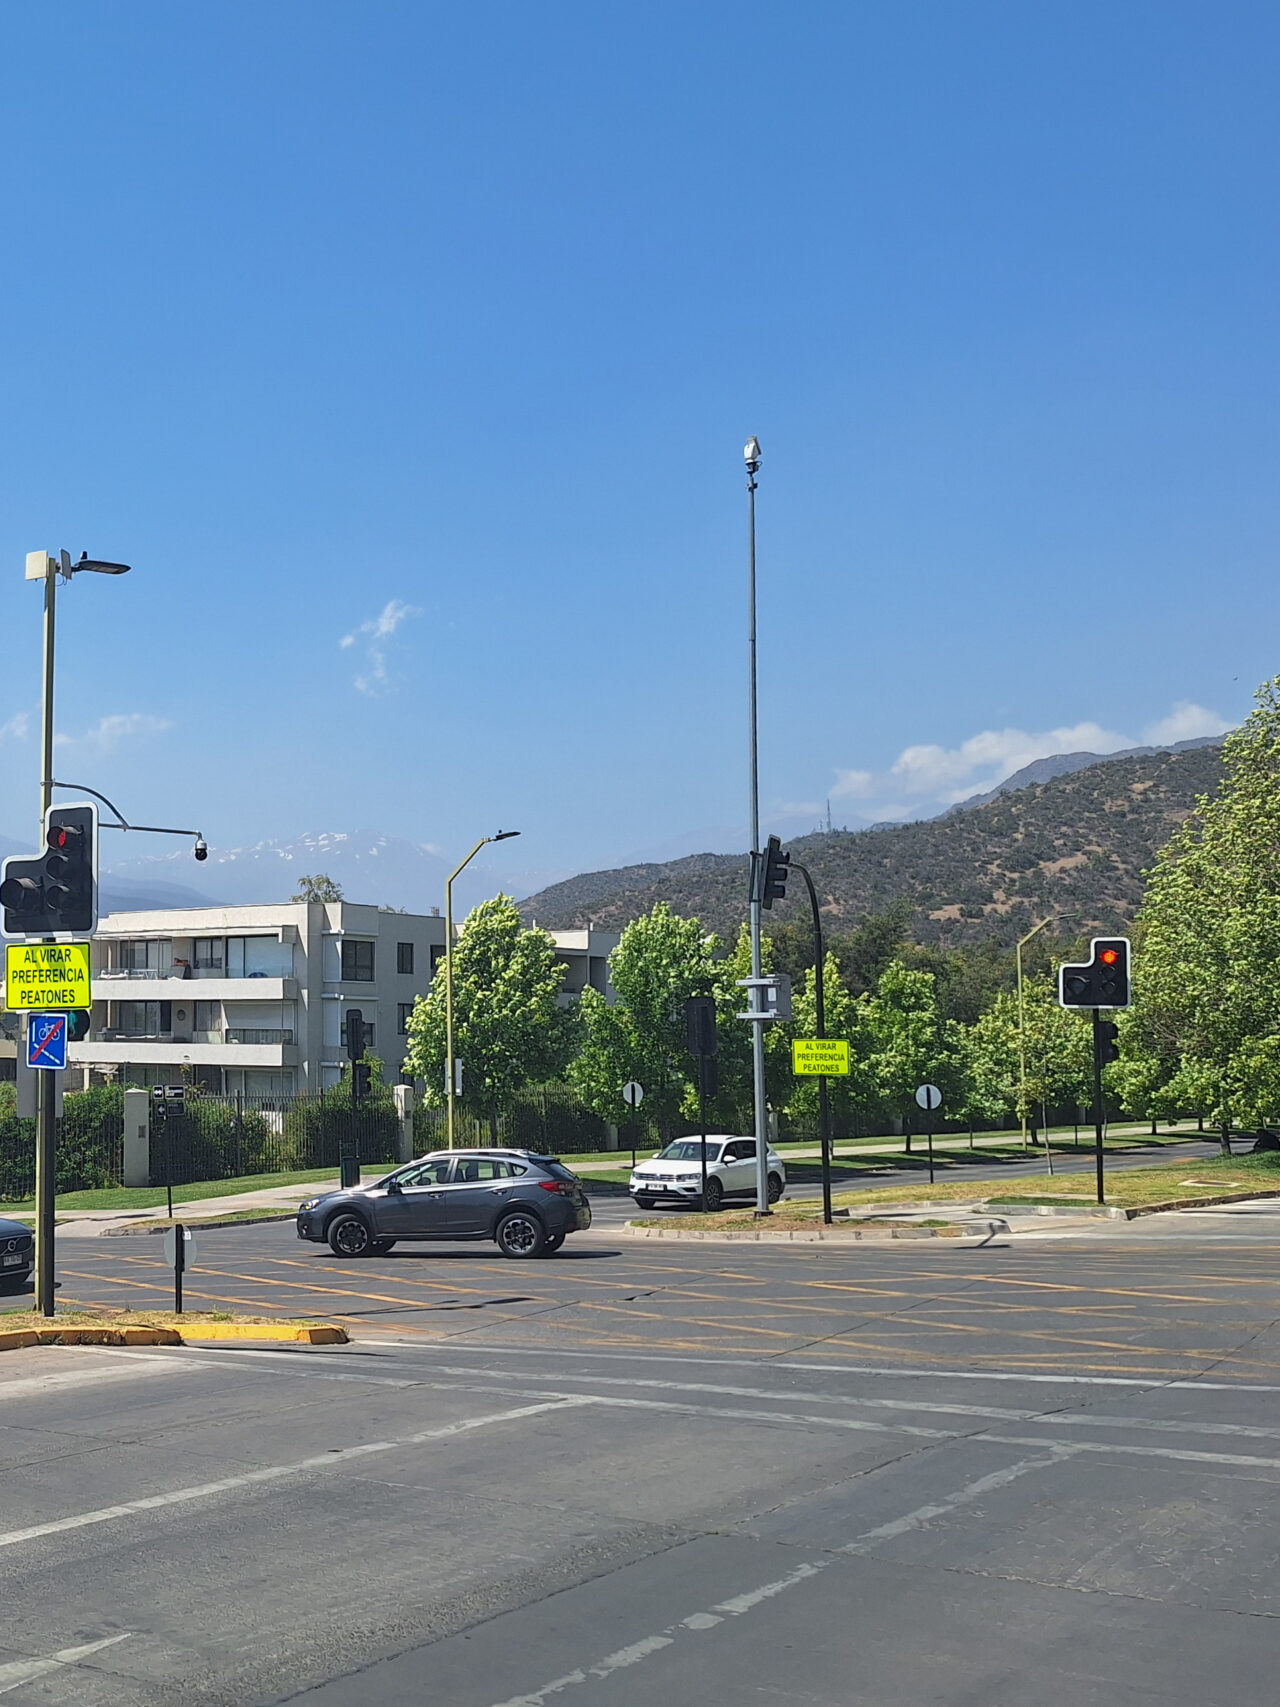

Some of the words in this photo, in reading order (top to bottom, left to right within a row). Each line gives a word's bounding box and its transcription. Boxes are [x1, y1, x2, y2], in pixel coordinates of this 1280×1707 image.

[24, 949, 37, 963] AL
[40, 949, 72, 962] VIRAR
[12, 968, 85, 984] PREFERENCIA
[20, 989, 75, 1004] PEATONES
[797, 1053, 845, 1061] PREFERENCIA
[803, 1064, 840, 1072] PEATONES
